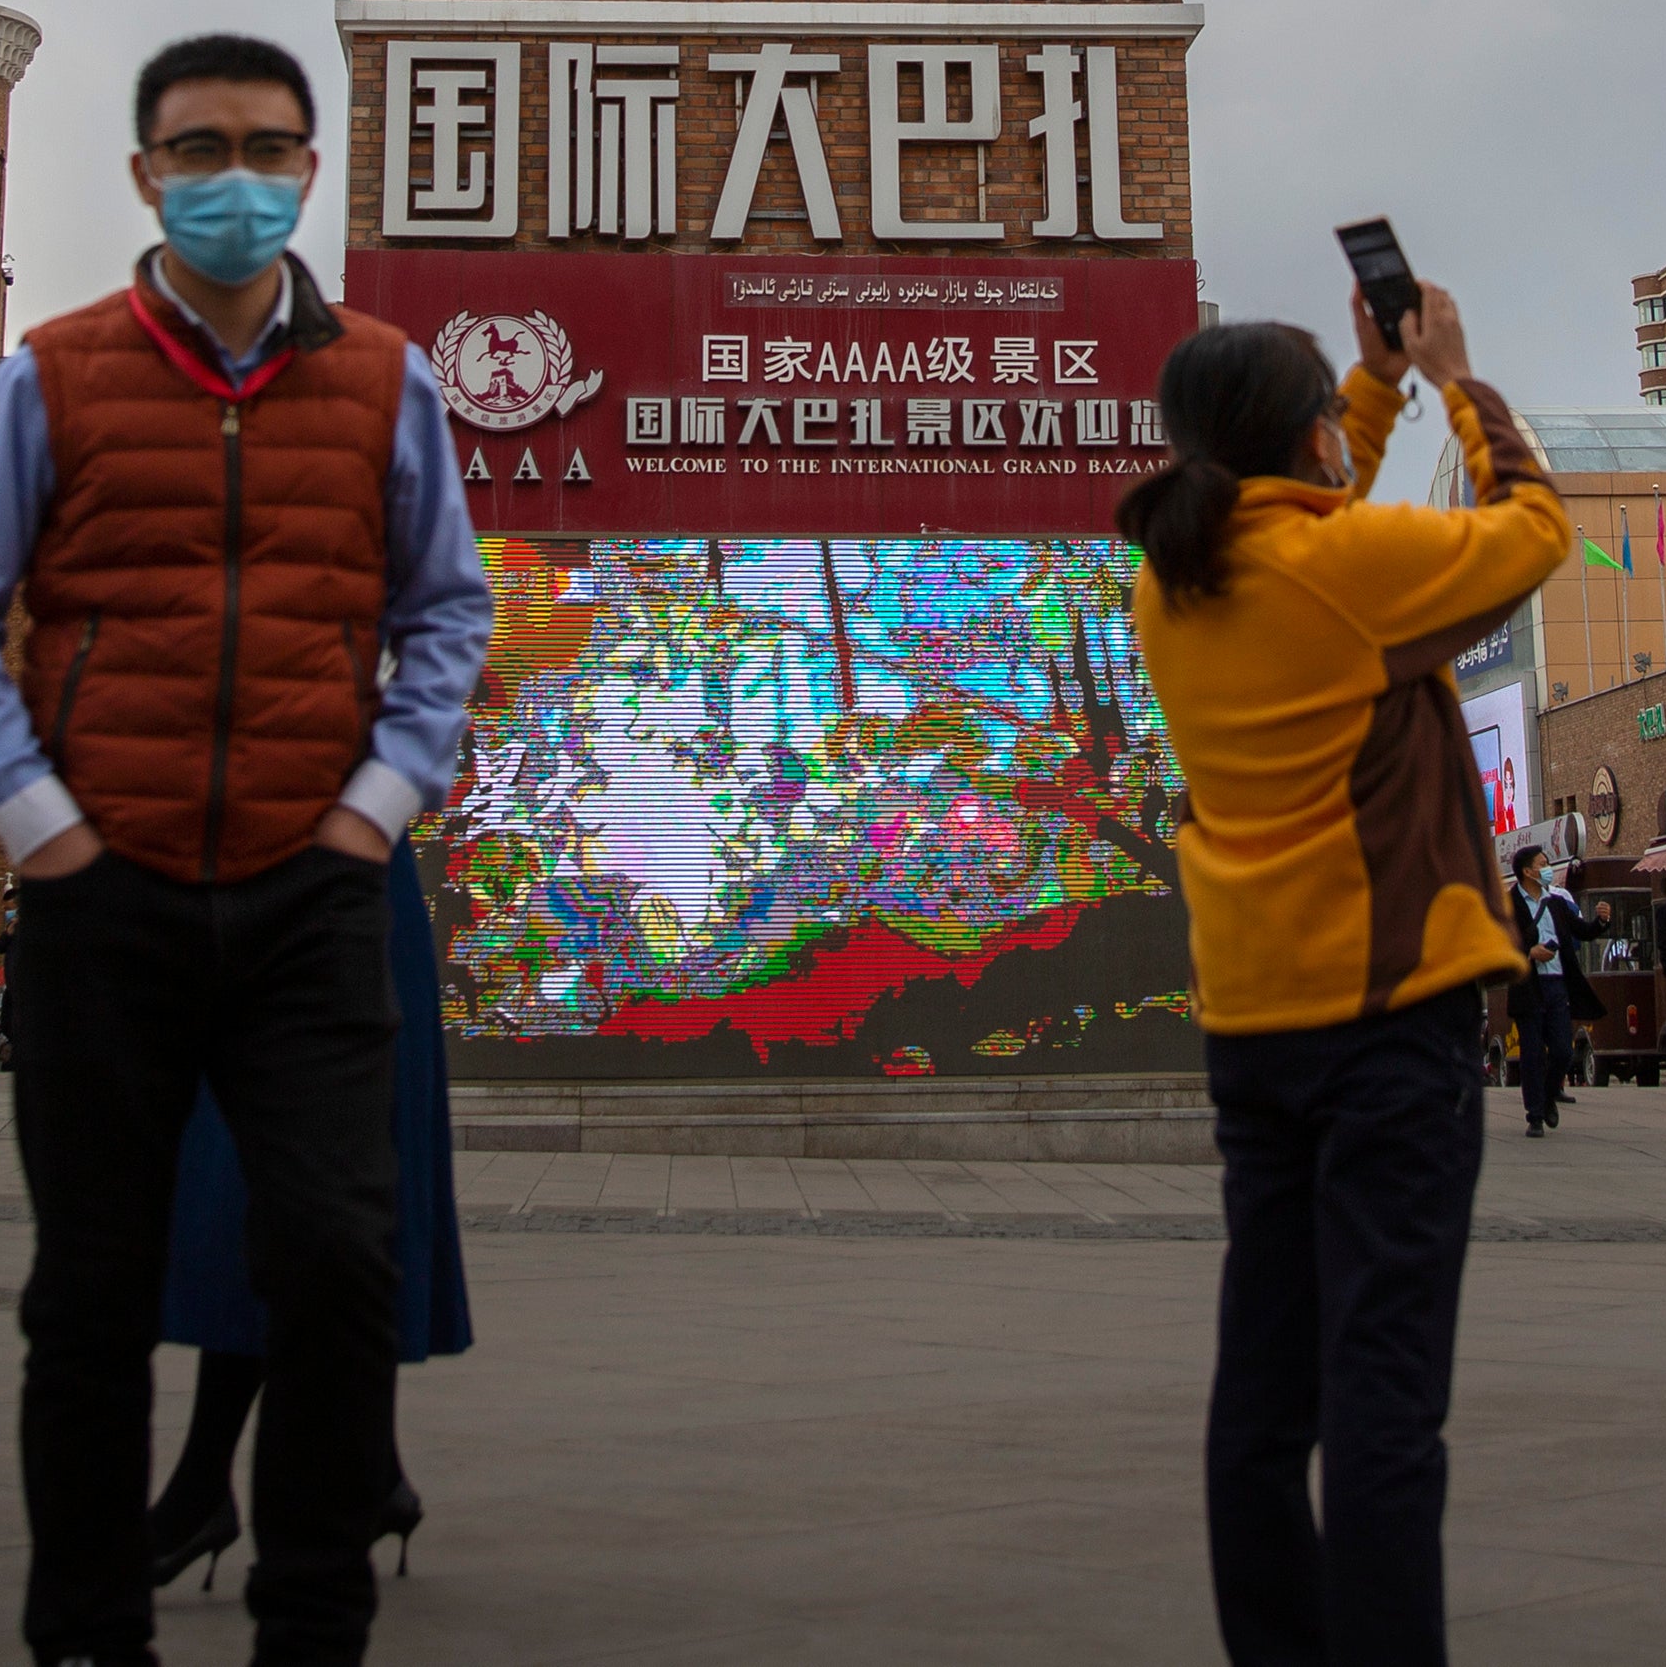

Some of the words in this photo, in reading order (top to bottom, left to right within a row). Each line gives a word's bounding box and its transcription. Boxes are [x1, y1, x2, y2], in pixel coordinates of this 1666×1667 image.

[381, 40, 1164, 240] 国际大巴扎
[941, 280, 968, 304] بازار
[703, 335, 1099, 384] 国家AAAA级景区
[627, 397, 1171, 446] 国际大巴扎景区欢迎您
[464, 447, 491, 480] A
[513, 447, 542, 480] A
[563, 447, 592, 480] A
[626, 458, 726, 473] WELCOME
[741, 458, 769, 473] TO
[778, 458, 820, 473] THE
[831, 459, 994, 474] INTERNATIONAL
[1003, 459, 1077, 474] GRAND
